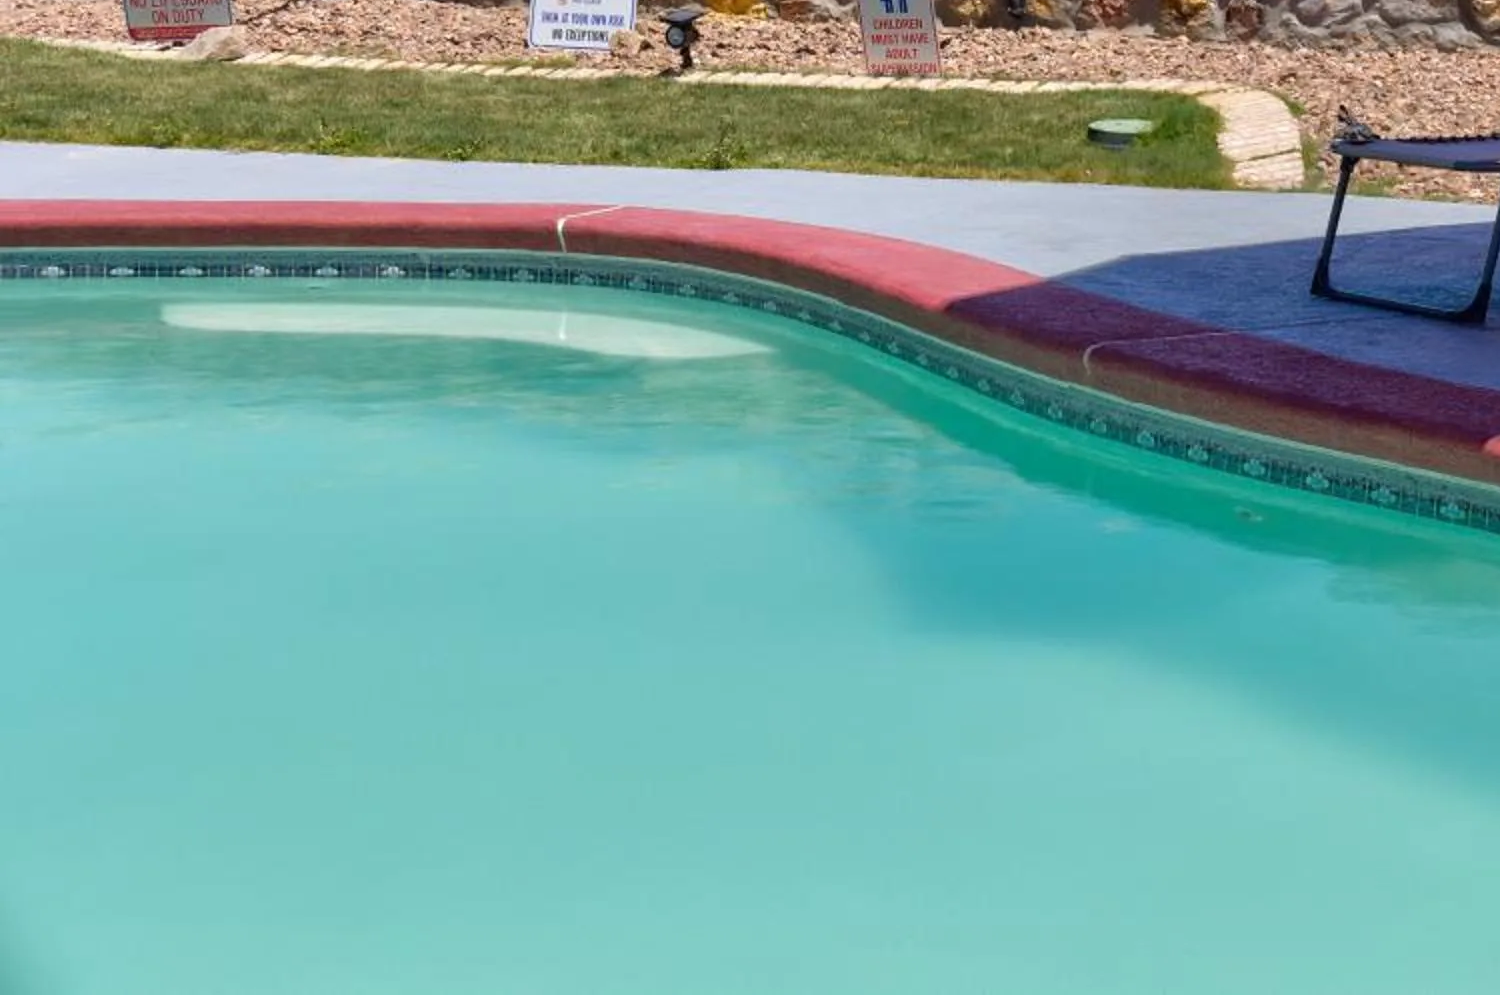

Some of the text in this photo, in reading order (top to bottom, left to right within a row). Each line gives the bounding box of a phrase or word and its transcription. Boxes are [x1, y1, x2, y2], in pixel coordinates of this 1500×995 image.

[152, 9, 205, 23] ON DUTY
[872, 18, 923, 29] CHILDREN
[872, 32, 930, 44] MUST HAVE
[885, 48, 920, 59] ADULT
